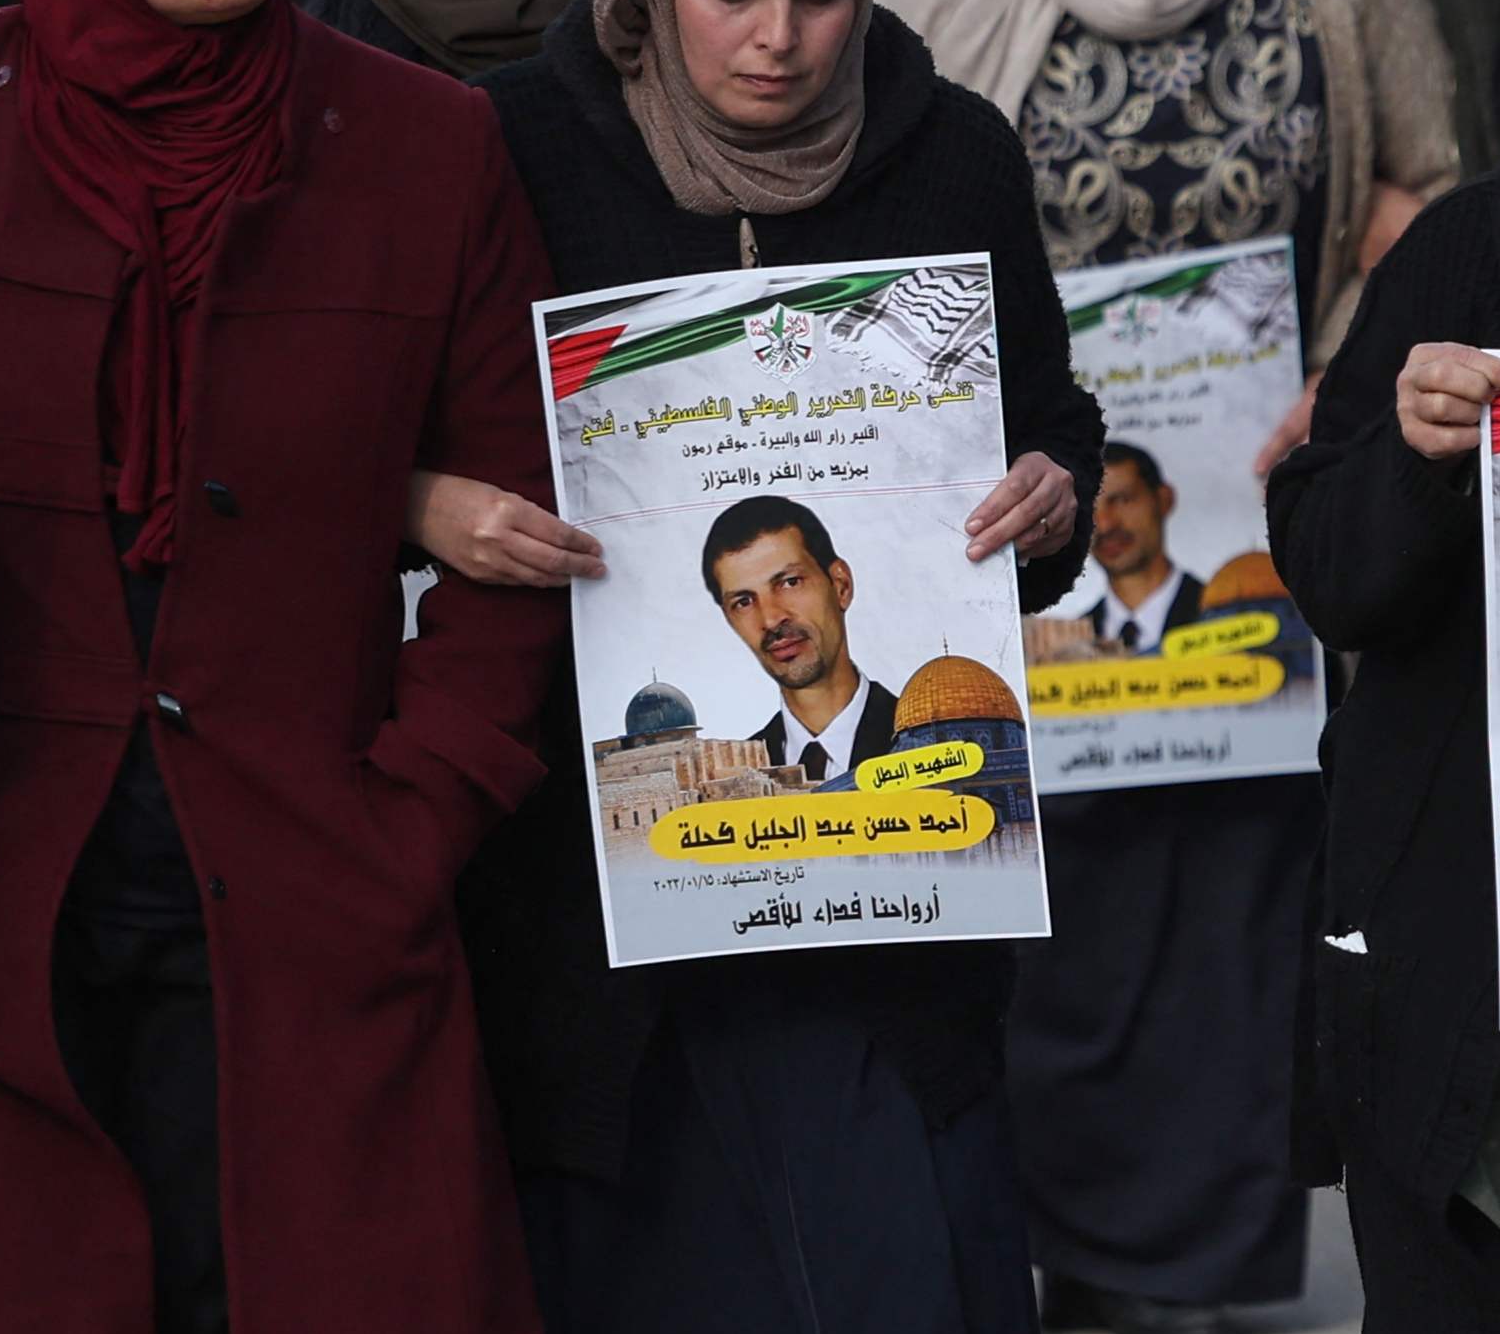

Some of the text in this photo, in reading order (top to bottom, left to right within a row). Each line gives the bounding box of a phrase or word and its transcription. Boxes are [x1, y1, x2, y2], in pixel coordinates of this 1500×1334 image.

[577, 383, 974, 447] تنعى حركة التحرير الوطني الفلسطيني فتح
[682, 425, 880, 458] اقليم رام الله والبيرة موقع رمون
[701, 460, 870, 492] بمزيد من الفخر والاعتزاز
[871, 747, 968, 789] الشهيد البطل
[677, 797, 967, 851] أحمد حسن عبد الجليل كحلة
[716, 868, 772, 888] الاستشهاد:
[773, 865, 805, 887] تاريخ
[731, 883, 940, 935] أرواحنا فداء للأقصى
